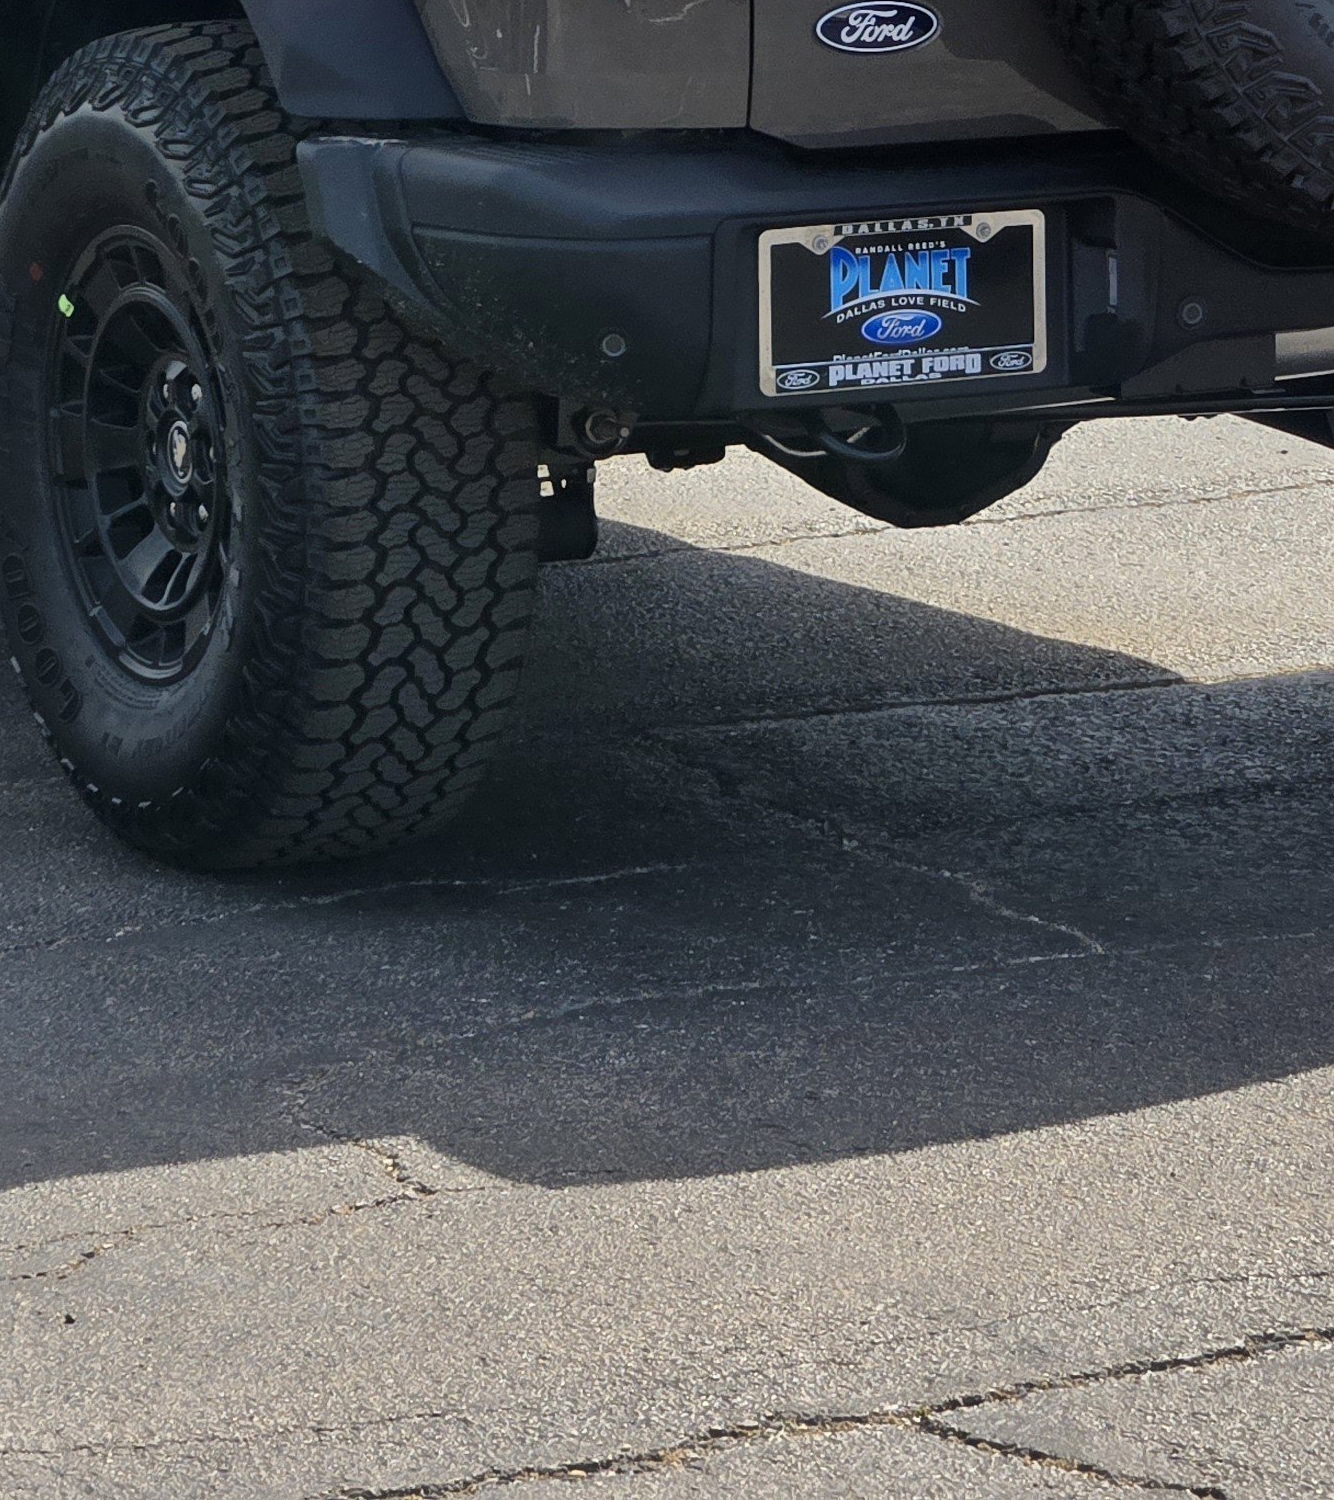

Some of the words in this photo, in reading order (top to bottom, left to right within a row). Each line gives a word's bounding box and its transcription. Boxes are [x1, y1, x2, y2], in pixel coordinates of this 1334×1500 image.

[840, 9, 916, 44] Ford
[855, 243, 903, 255] RANDALL
[830, 245, 971, 313] PLANET
[836, 298, 886, 324] DALLAS
[891, 296, 924, 307] LOVE
[929, 297, 966, 313] FIELD
[875, 314, 926, 341] Ford
[828, 359, 915, 387] PLANET
[921, 353, 982, 374] FORD
[996, 352, 1026, 369] Ford
[784, 371, 813, 388] Ford
